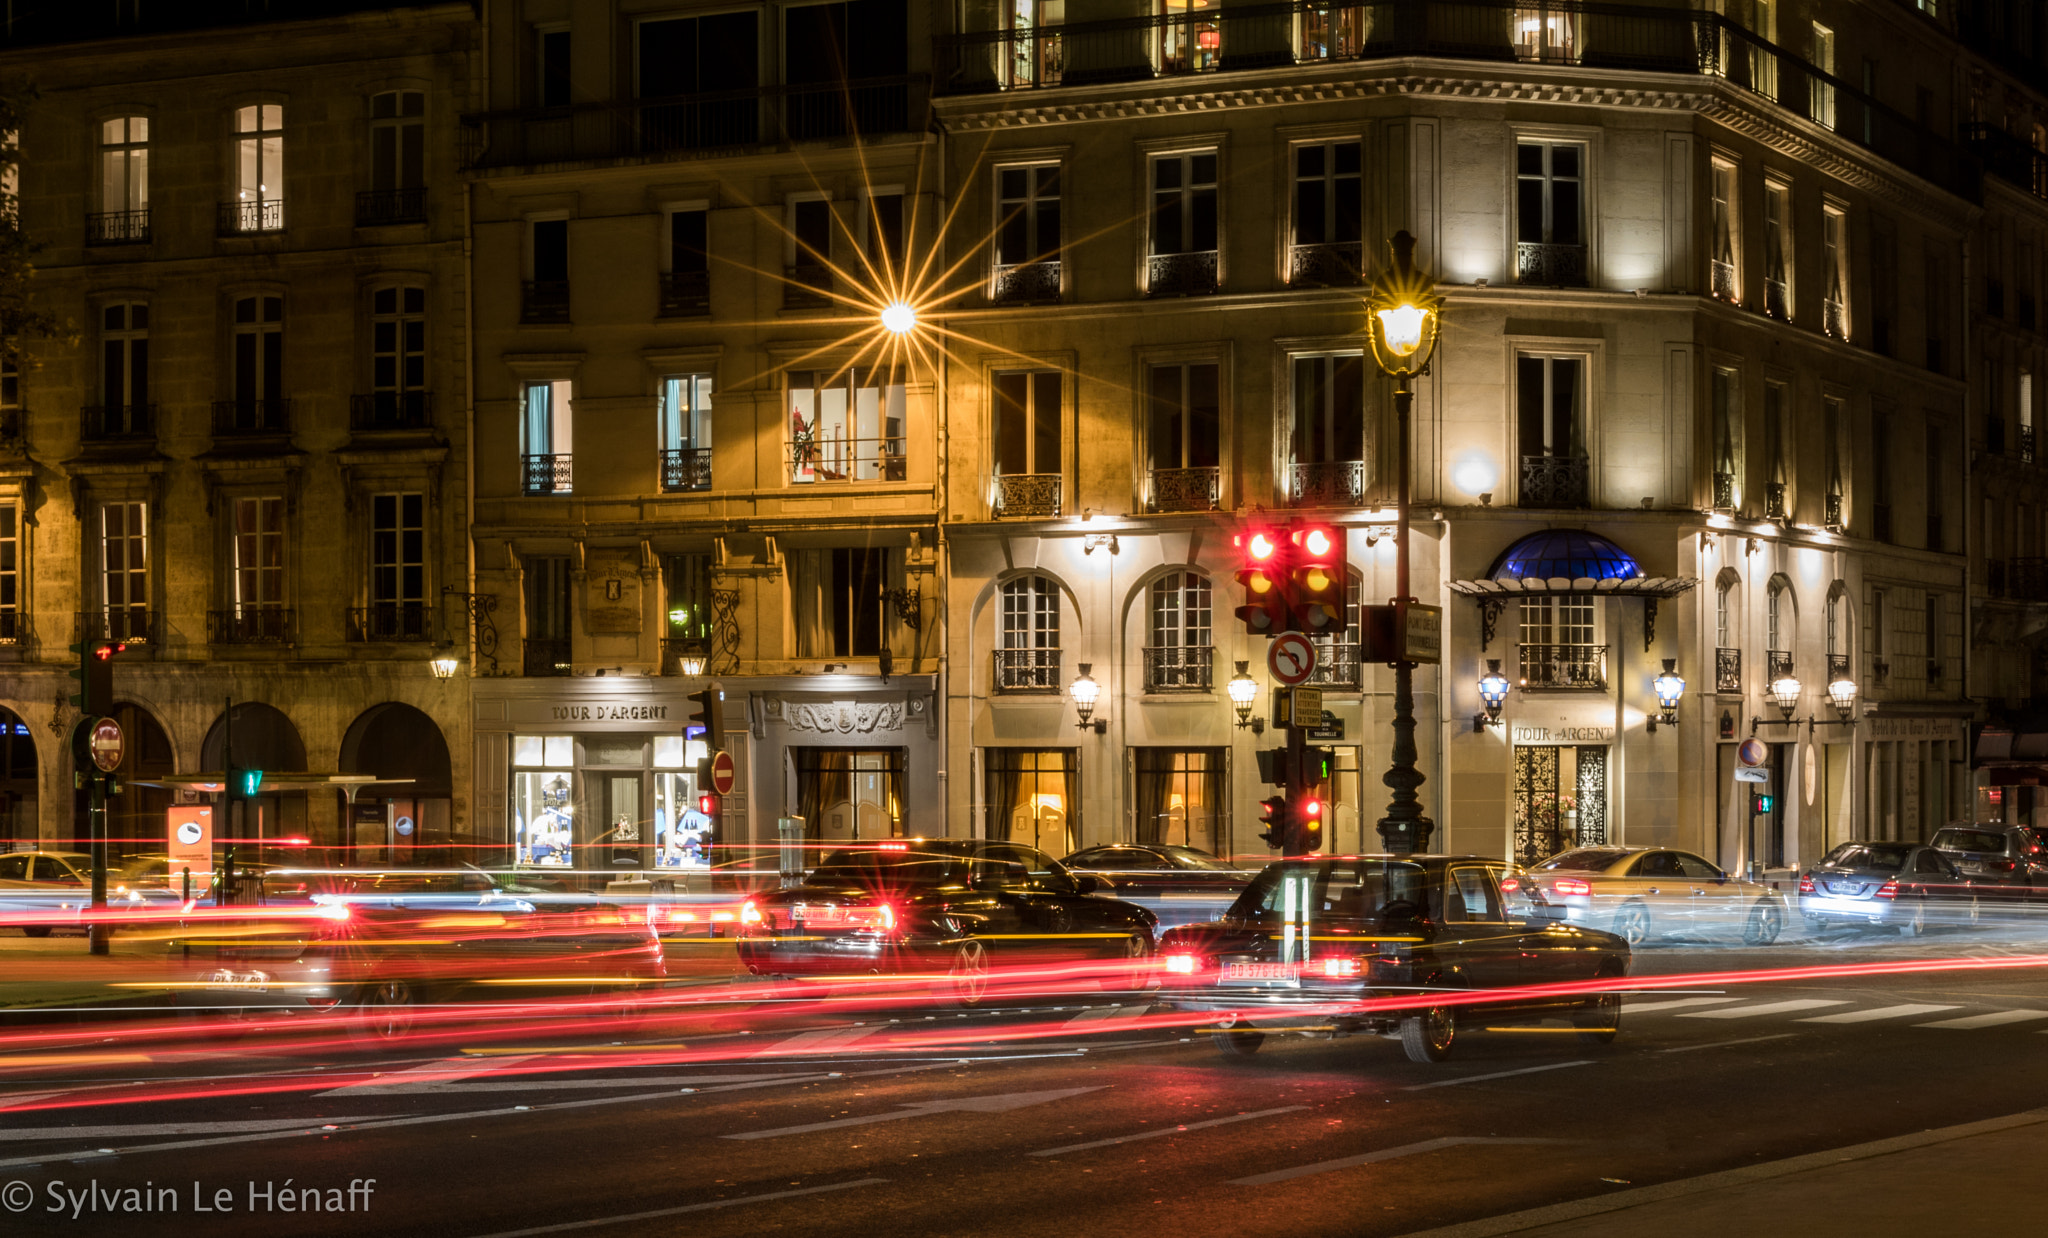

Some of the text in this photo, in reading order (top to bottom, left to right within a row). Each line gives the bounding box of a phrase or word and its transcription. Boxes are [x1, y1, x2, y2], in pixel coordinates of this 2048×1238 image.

[1408, 634, 1439, 650] TOURNELLE
[1297, 700, 1320, 709] ATTENTION
[552, 706, 668, 720] TOUR D'ARGENT
[1297, 708, 1320, 717] TRAVERSEZ
[1297, 716, 1303, 724] EN
[1308, 717, 1320, 725] TEMPS
[1515, 727, 1551, 741] TOUR
